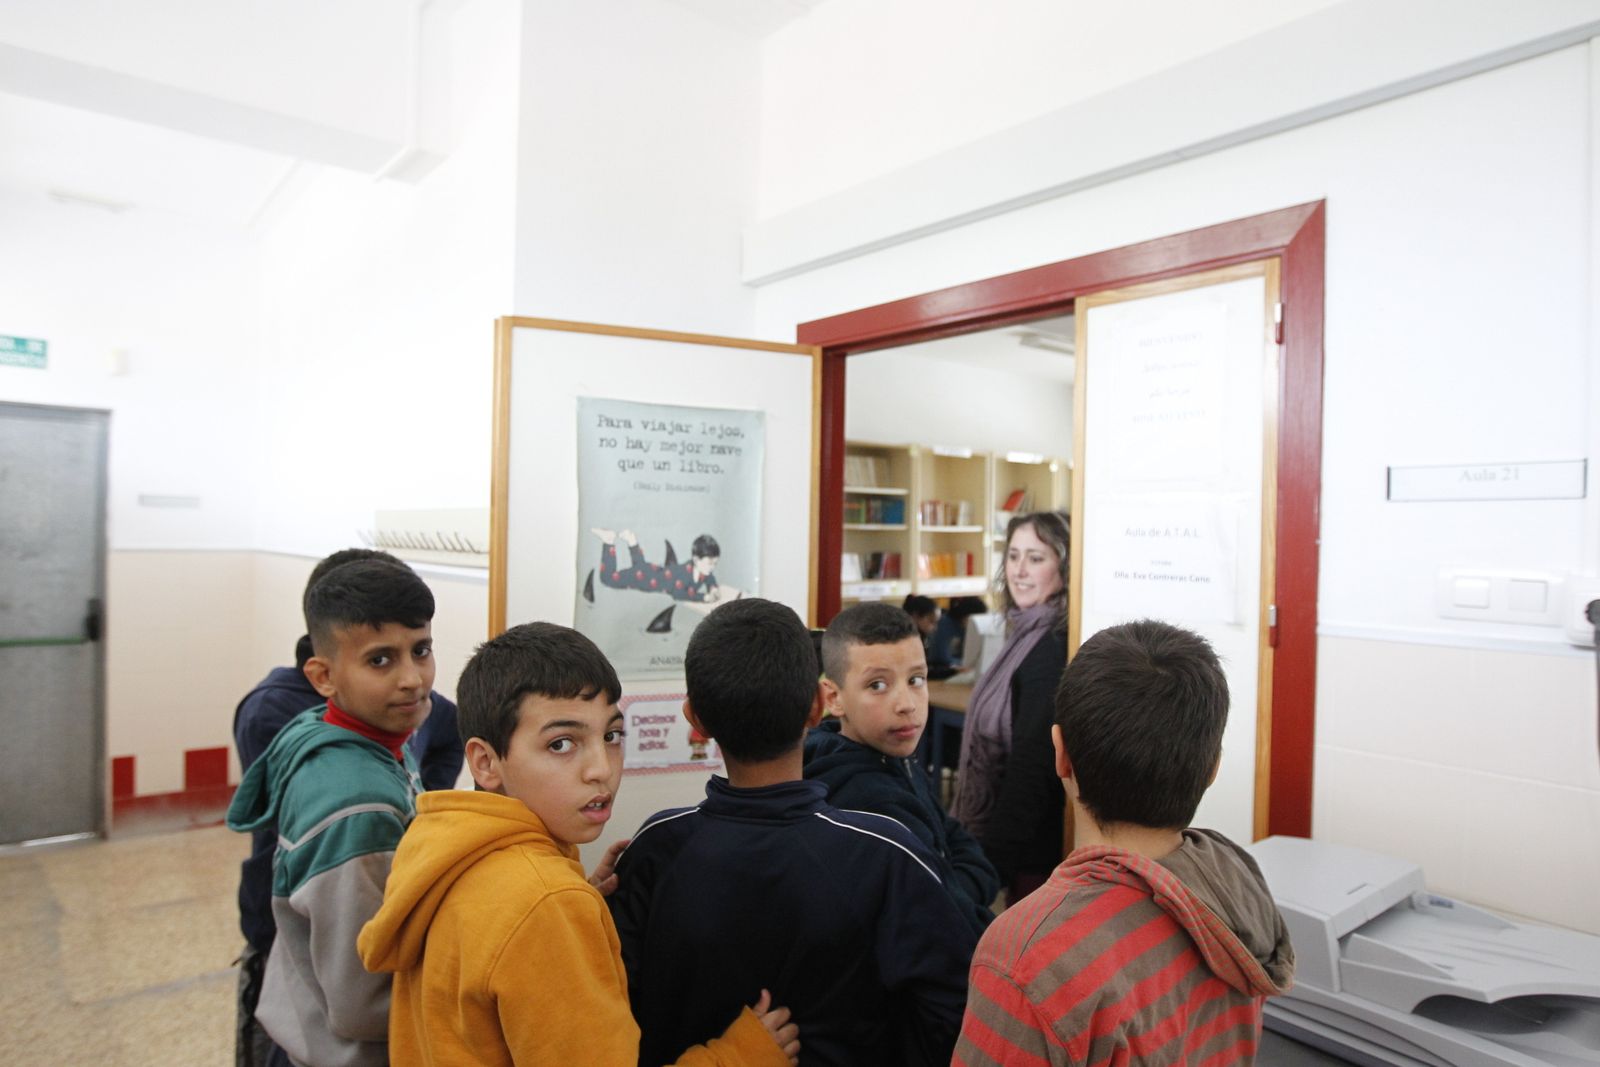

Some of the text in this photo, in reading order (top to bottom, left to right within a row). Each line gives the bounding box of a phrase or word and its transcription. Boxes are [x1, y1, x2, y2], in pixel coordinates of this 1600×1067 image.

[597, 414, 745, 439] Para viajar lejos,
[598, 437, 743, 456] no hay mejor nave
[617, 458, 725, 474] que un libro.
[1459, 467, 1520, 482] Aula 21
[1125, 527, 1146, 537] Aula
[1148, 527, 1161, 537] de
[638, 728, 662, 739] hola
